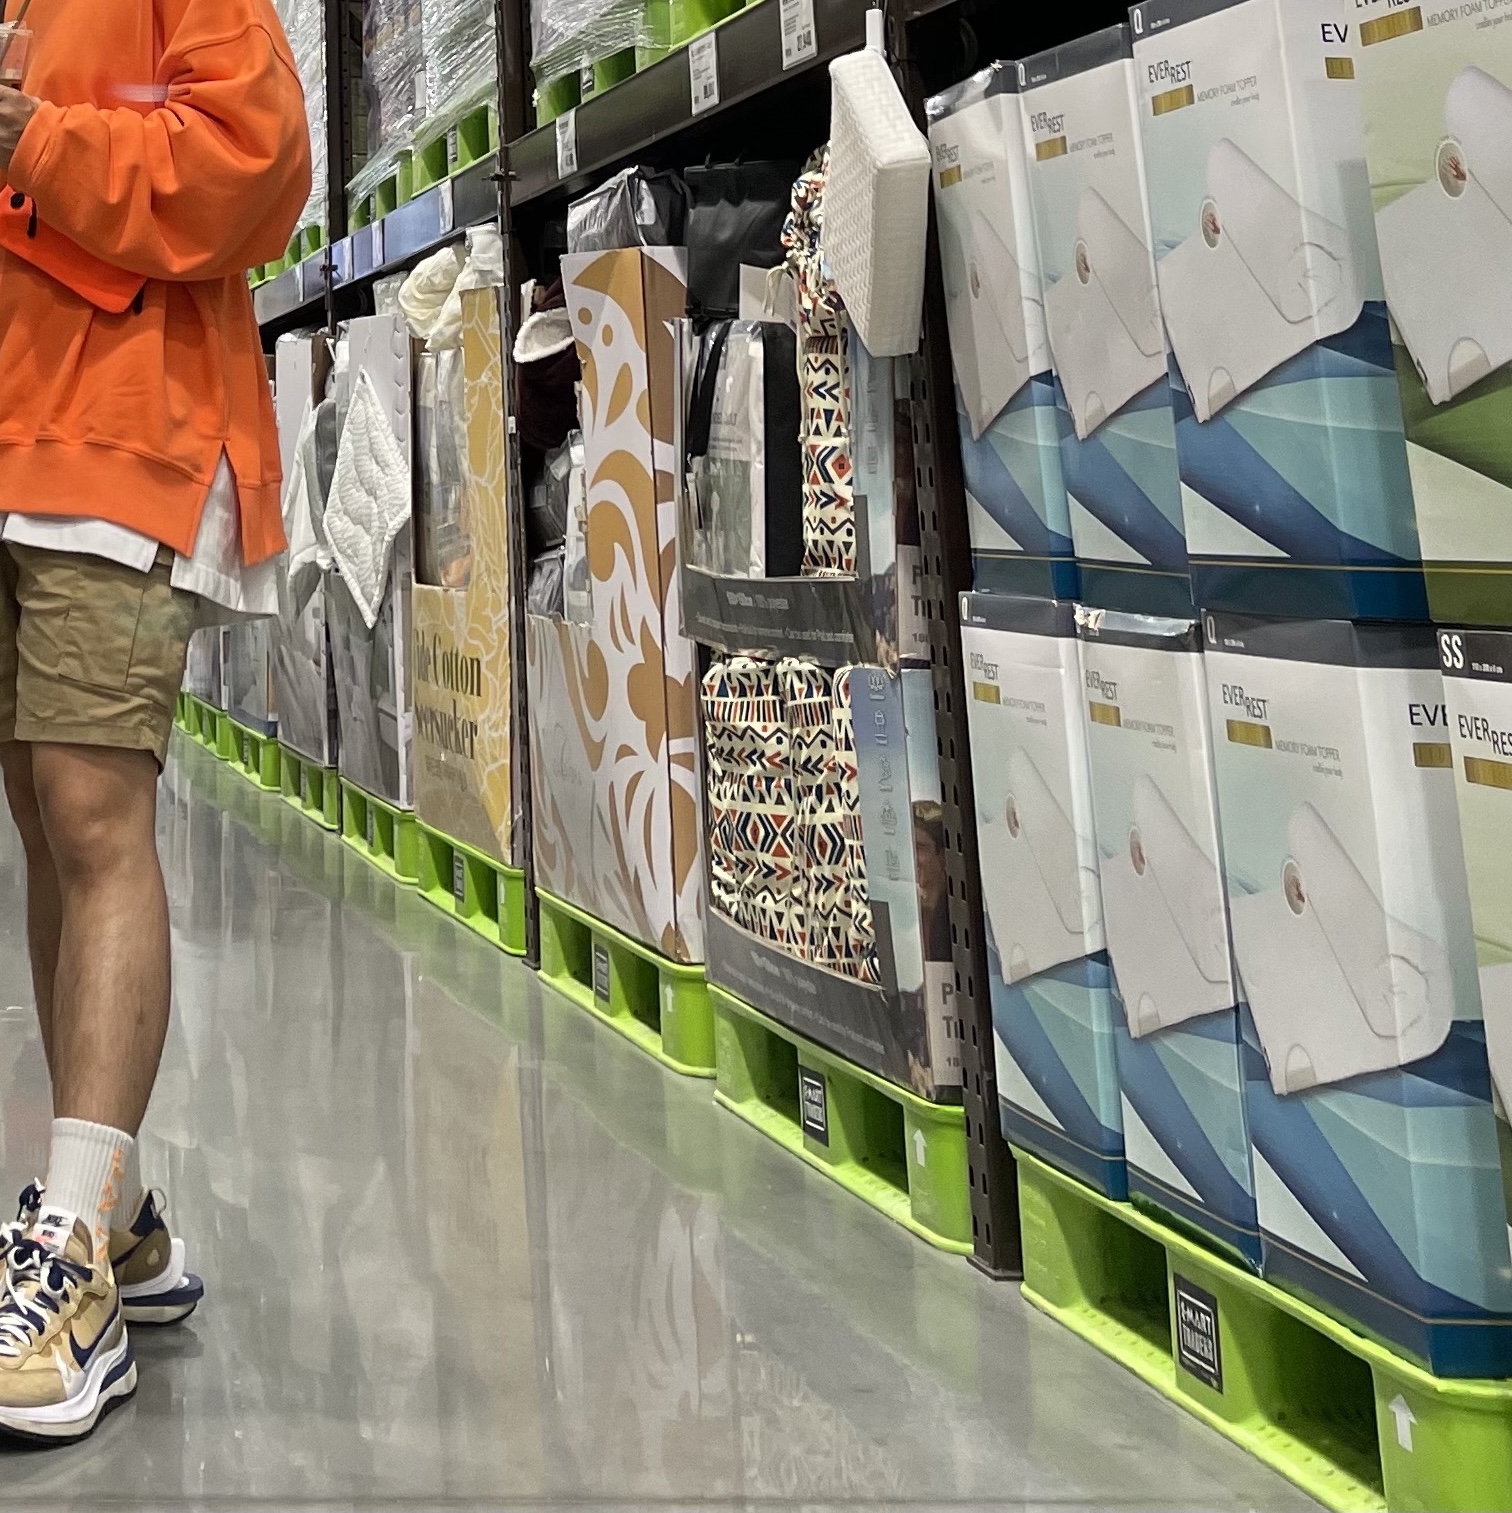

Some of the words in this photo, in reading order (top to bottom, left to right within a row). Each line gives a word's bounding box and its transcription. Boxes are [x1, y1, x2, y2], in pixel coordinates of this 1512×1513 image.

[1427, 6, 1459, 27] MEMORY
[1321, 23, 1348, 43] EV
[433, 632, 481, 697] Cotton
[1441, 634, 1464, 669] SS
